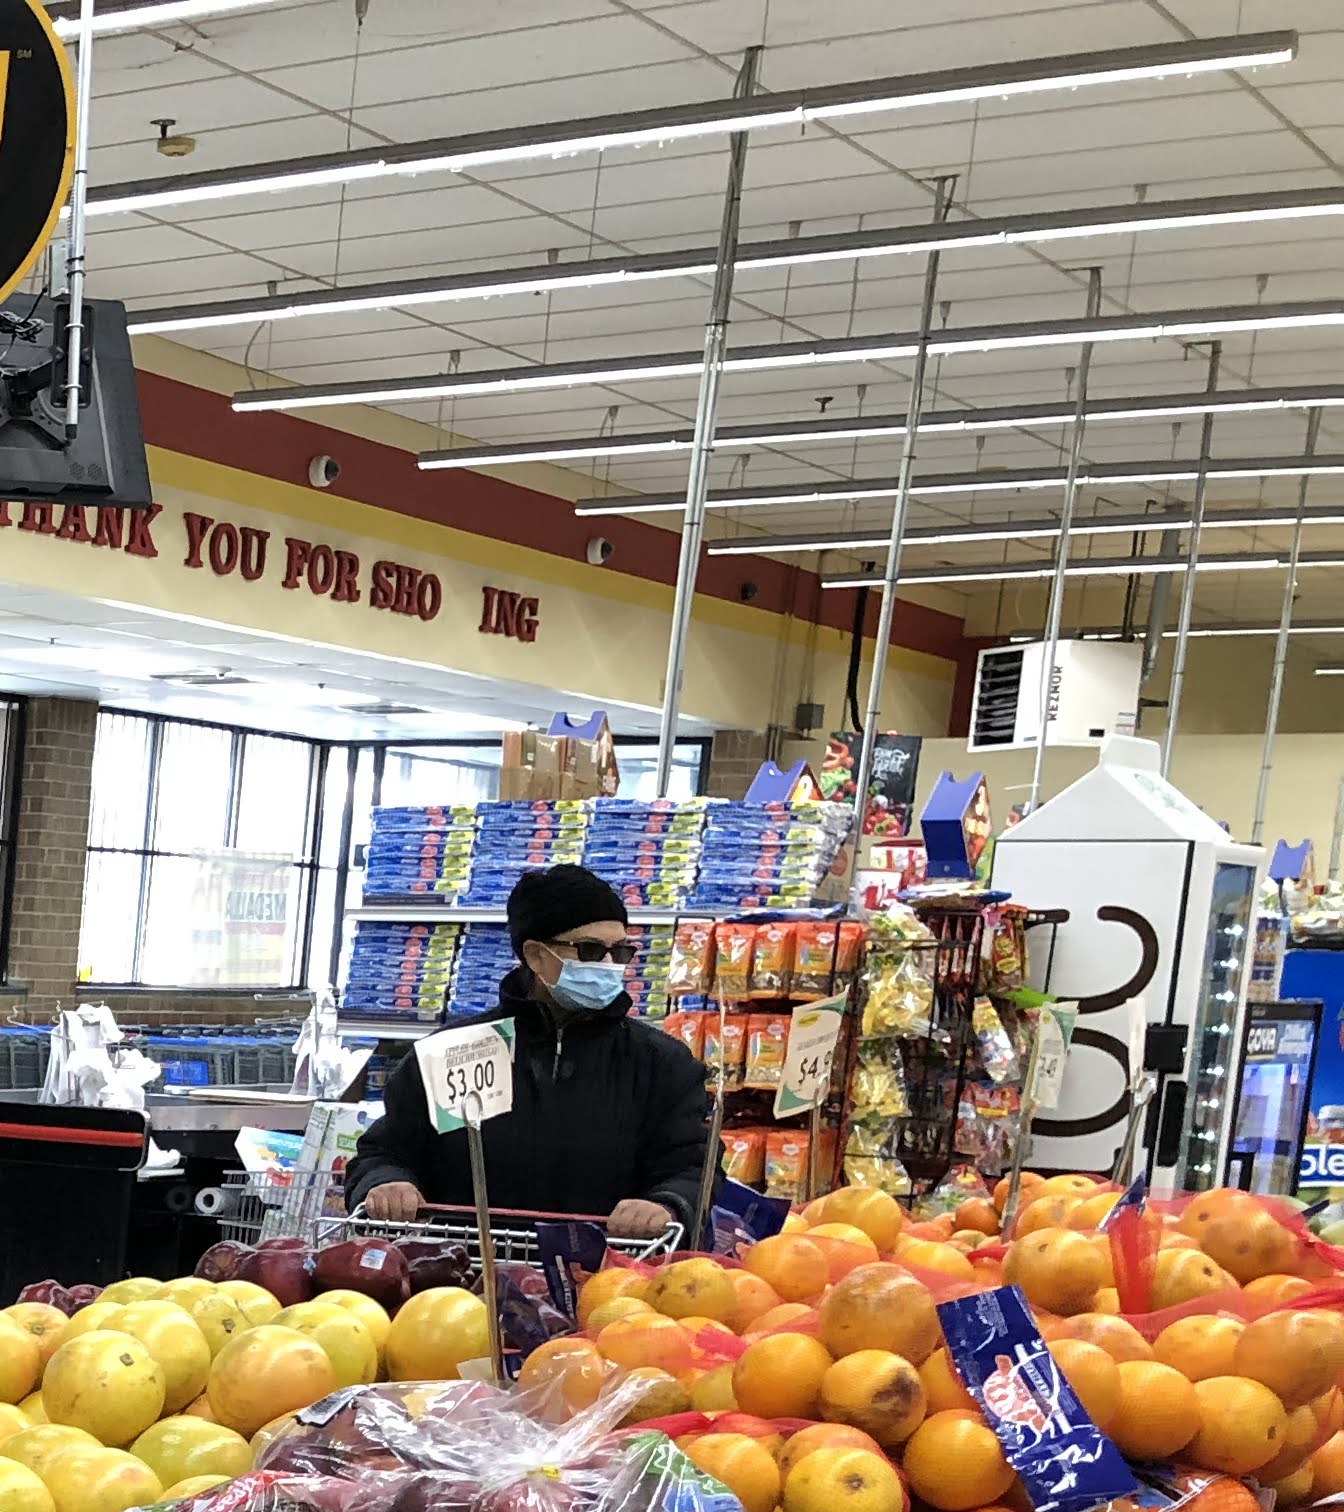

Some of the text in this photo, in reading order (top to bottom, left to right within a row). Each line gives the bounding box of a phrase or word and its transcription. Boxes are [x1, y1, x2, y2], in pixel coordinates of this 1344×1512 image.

[183, 511, 271, 581] YOU
[281, 537, 361, 603] FOR
[1047, 665, 1063, 722] REZNOR
[1301, 1143, 1344, 1177] ole
